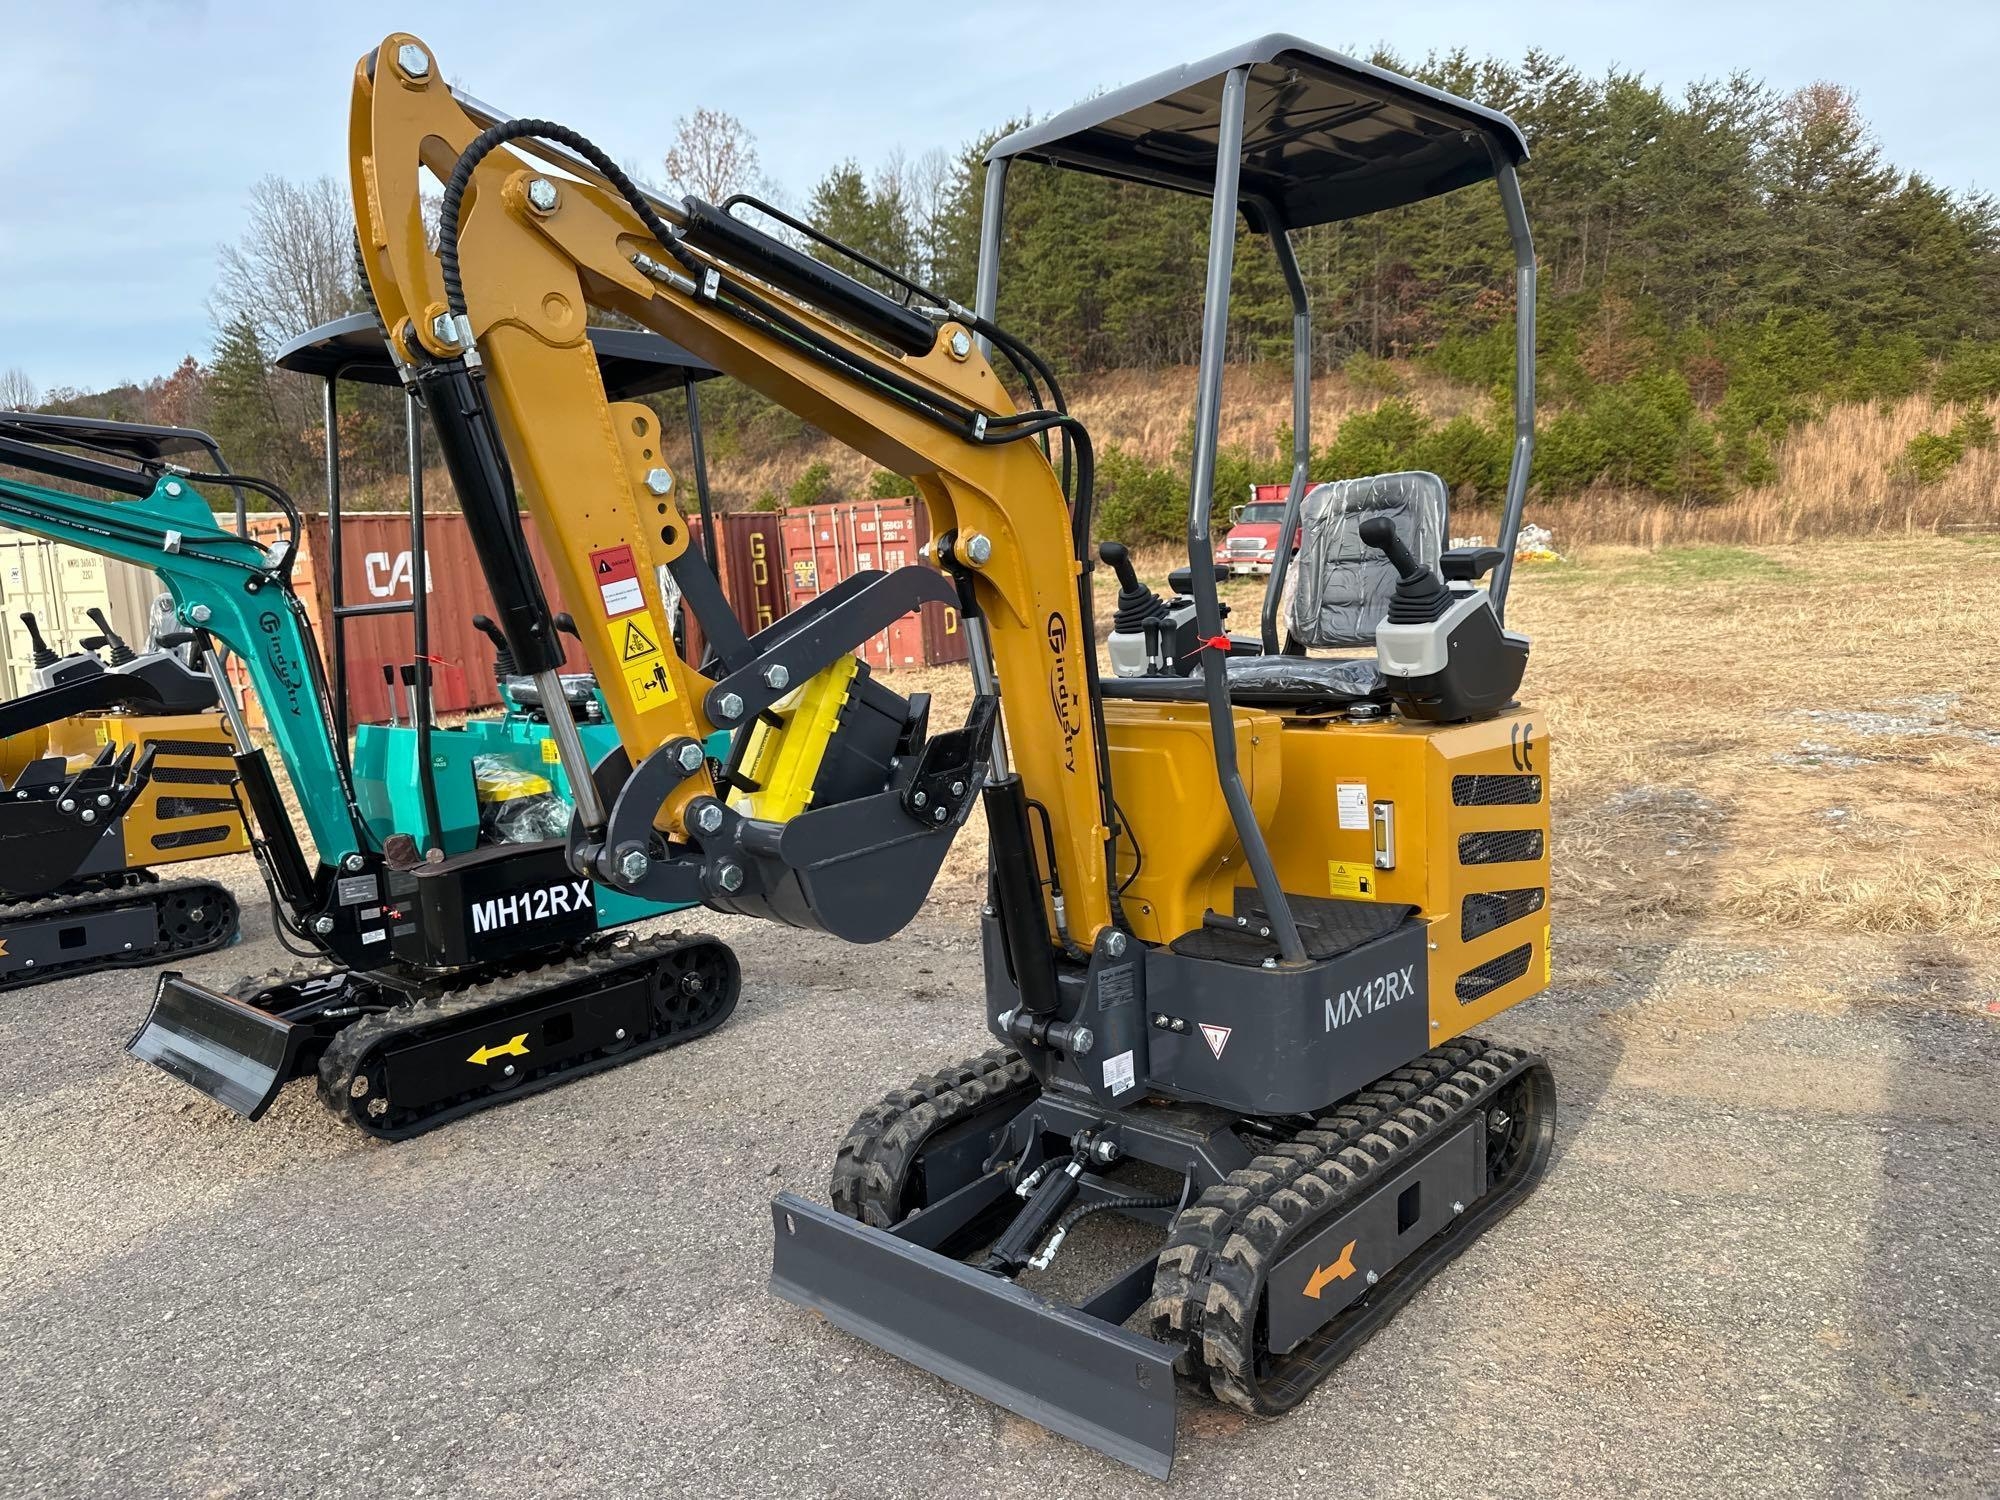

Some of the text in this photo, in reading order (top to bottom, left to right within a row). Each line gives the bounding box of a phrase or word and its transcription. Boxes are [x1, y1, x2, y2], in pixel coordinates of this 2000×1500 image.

[1511, 722, 1533, 772] CE
[471, 879, 593, 934] MH12RX
[1325, 963, 1415, 1033] MX12RX
